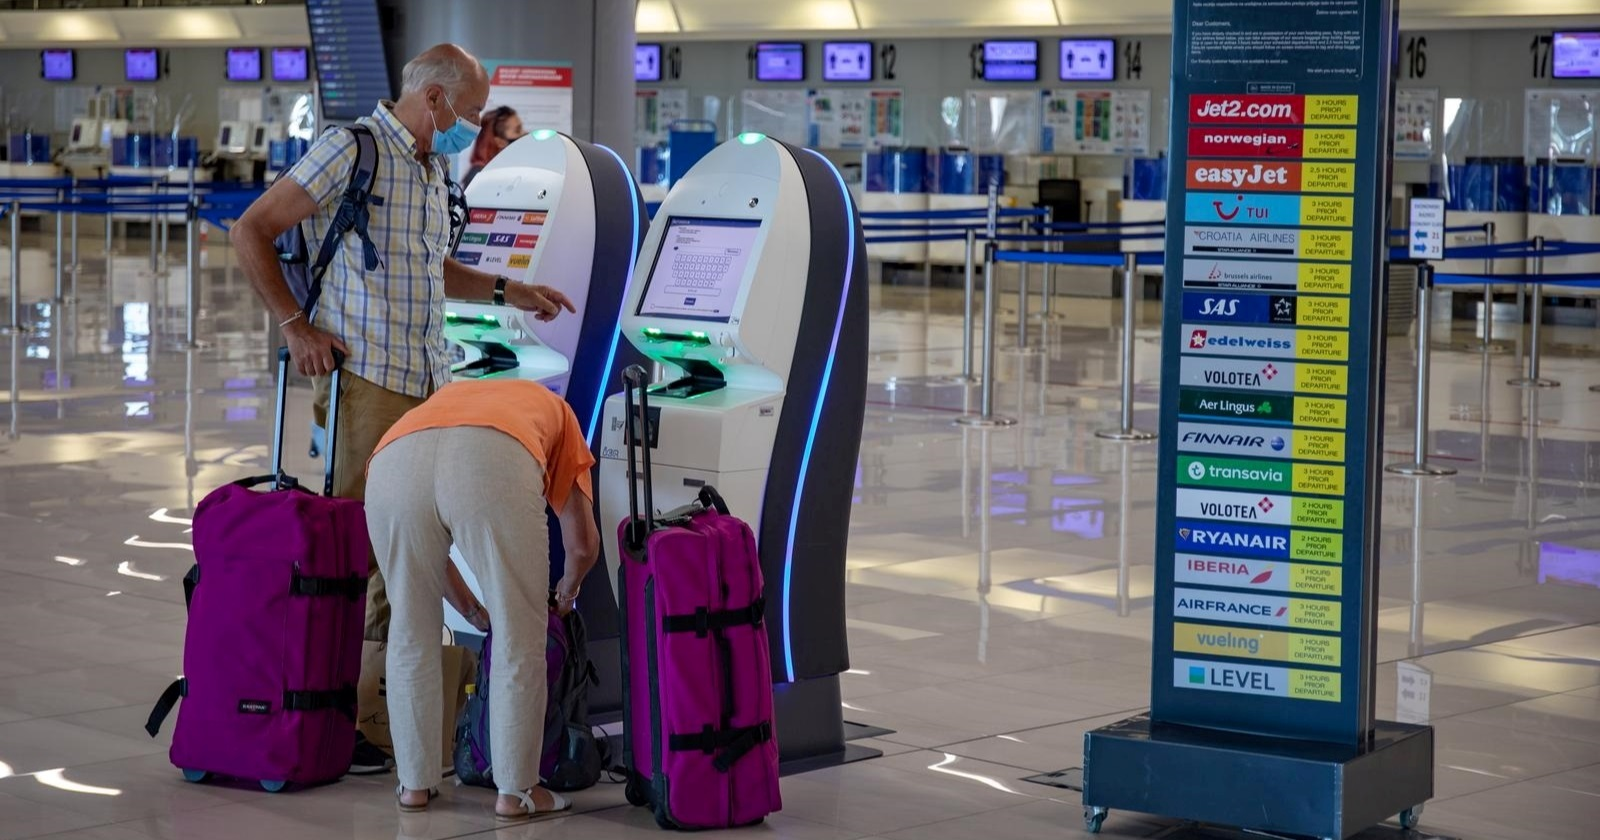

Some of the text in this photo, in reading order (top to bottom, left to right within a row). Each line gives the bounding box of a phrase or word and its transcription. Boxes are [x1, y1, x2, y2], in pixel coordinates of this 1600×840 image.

[668, 45, 682, 79] 10
[880, 44, 895, 79] 12
[969, 44, 984, 79] 13
[1125, 41, 1141, 79] 14
[1407, 36, 1426, 78] 16
[1531, 36, 1552, 78] 17
[1198, 100, 1291, 117] Jet2.com
[1204, 134, 1286, 146] norwegian
[1195, 165, 1287, 187] easyJet
[1247, 208, 1268, 218] TUI
[1199, 232, 1294, 243] CROATIA AIRLINES
[1199, 298, 1239, 315] SAS
[1208, 336, 1291, 348] edelweiss
[1205, 370, 1260, 386] VOLOTEA
[1199, 399, 1254, 414] Aer Lingus
[1182, 432, 1264, 447] FINNAIR
[1209, 465, 1283, 482] transavia
[1201, 502, 1256, 519] VOLOTEA
[1192, 530, 1286, 550] RYANAIR
[1188, 560, 1249, 575] IBERIA
[1178, 598, 1271, 616] AIRFRANCE
[1197, 632, 1258, 654] vueling
[1294, 653, 1334, 661] DEPARTURE
[1211, 668, 1275, 691] LEVEL
